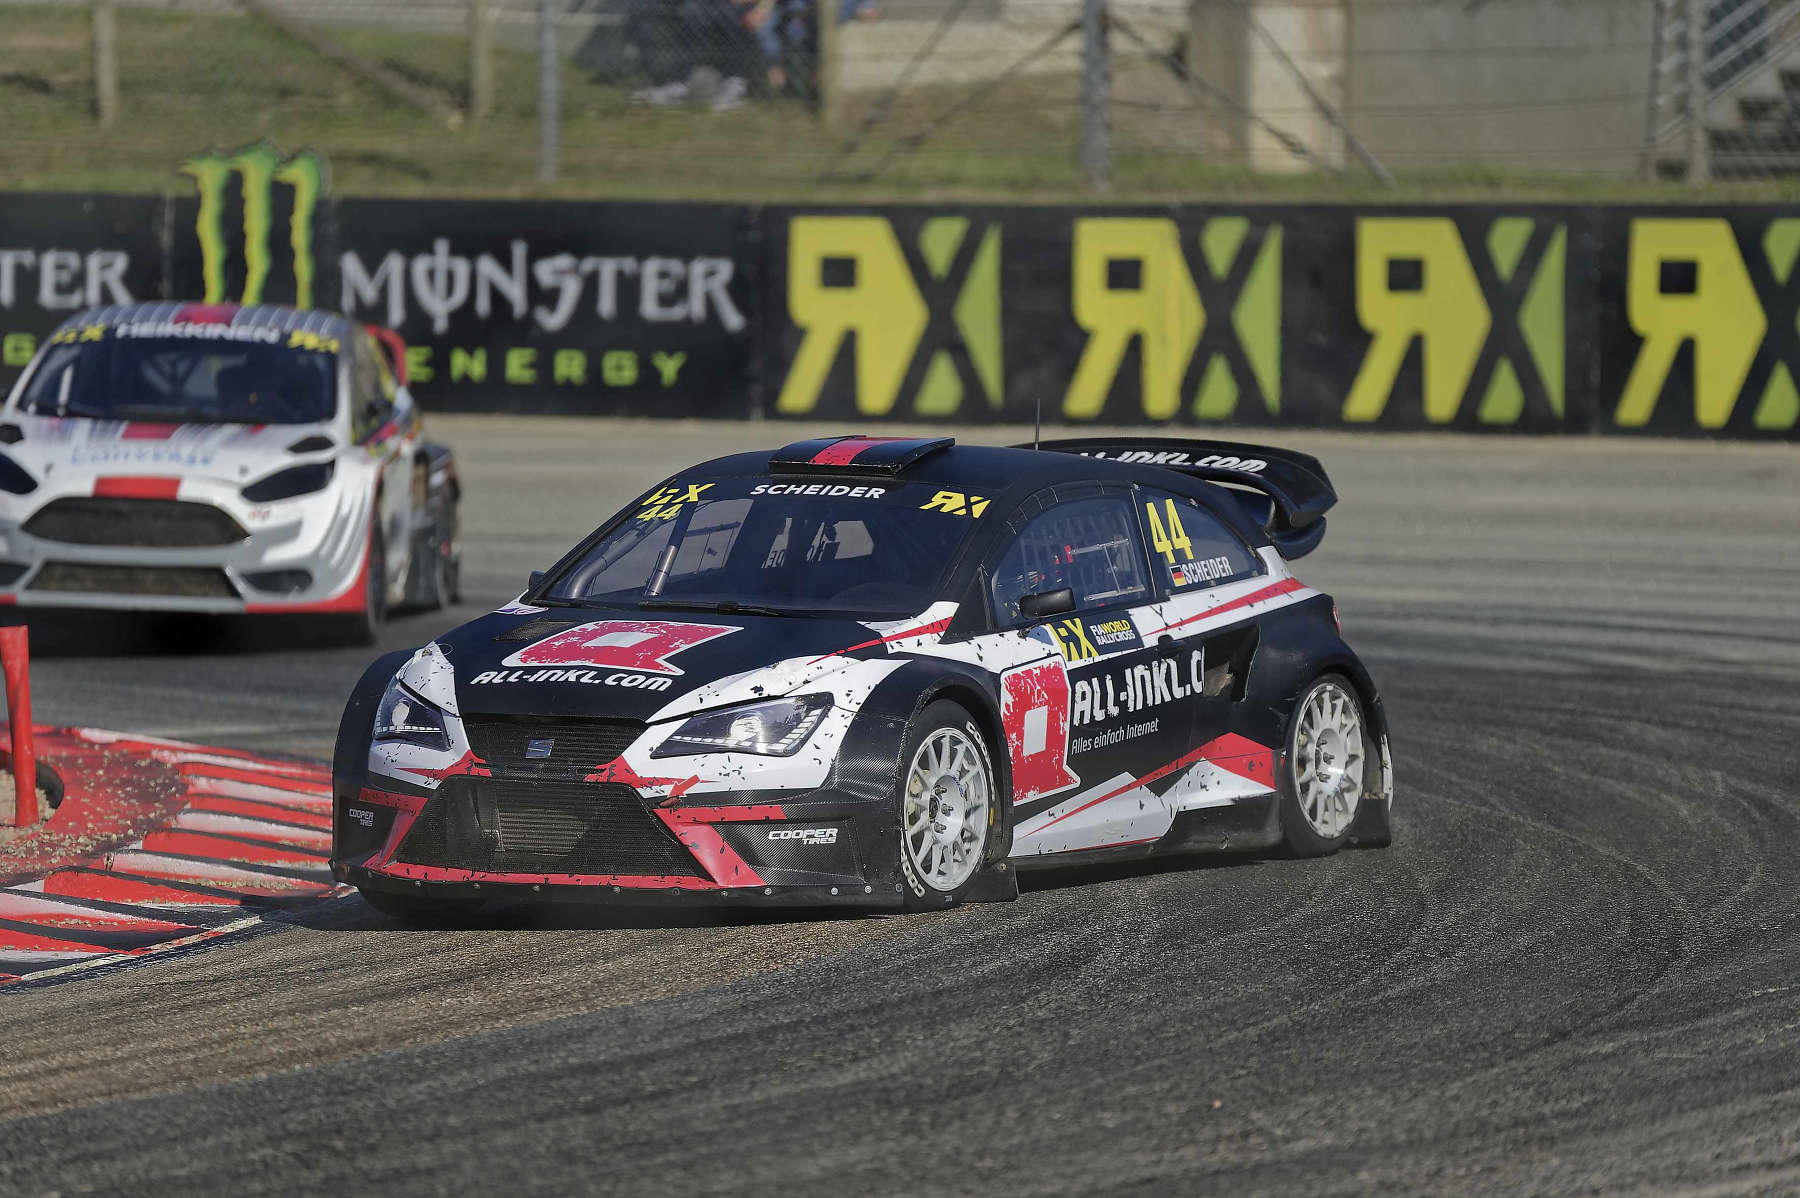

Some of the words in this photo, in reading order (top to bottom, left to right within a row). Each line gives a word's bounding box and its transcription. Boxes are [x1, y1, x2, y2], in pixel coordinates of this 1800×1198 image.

[340, 238, 746, 334] MONSTER
[405, 347, 687, 386] ENERGY
[750, 484, 886, 499] SCHEIDER
[636, 503, 684, 522] 44
[1146, 498, 1194, 564] 44
[1182, 556, 1234, 584] SCHEIDER
[1094, 629, 1136, 646] RALLYCROSS
[1071, 737, 1092, 756] Alles
[1093, 727, 1125, 749] einfach
[1126, 717, 1160, 740] Internet
[768, 828, 839, 840] COOPER
[801, 836, 837, 845] TIRES
